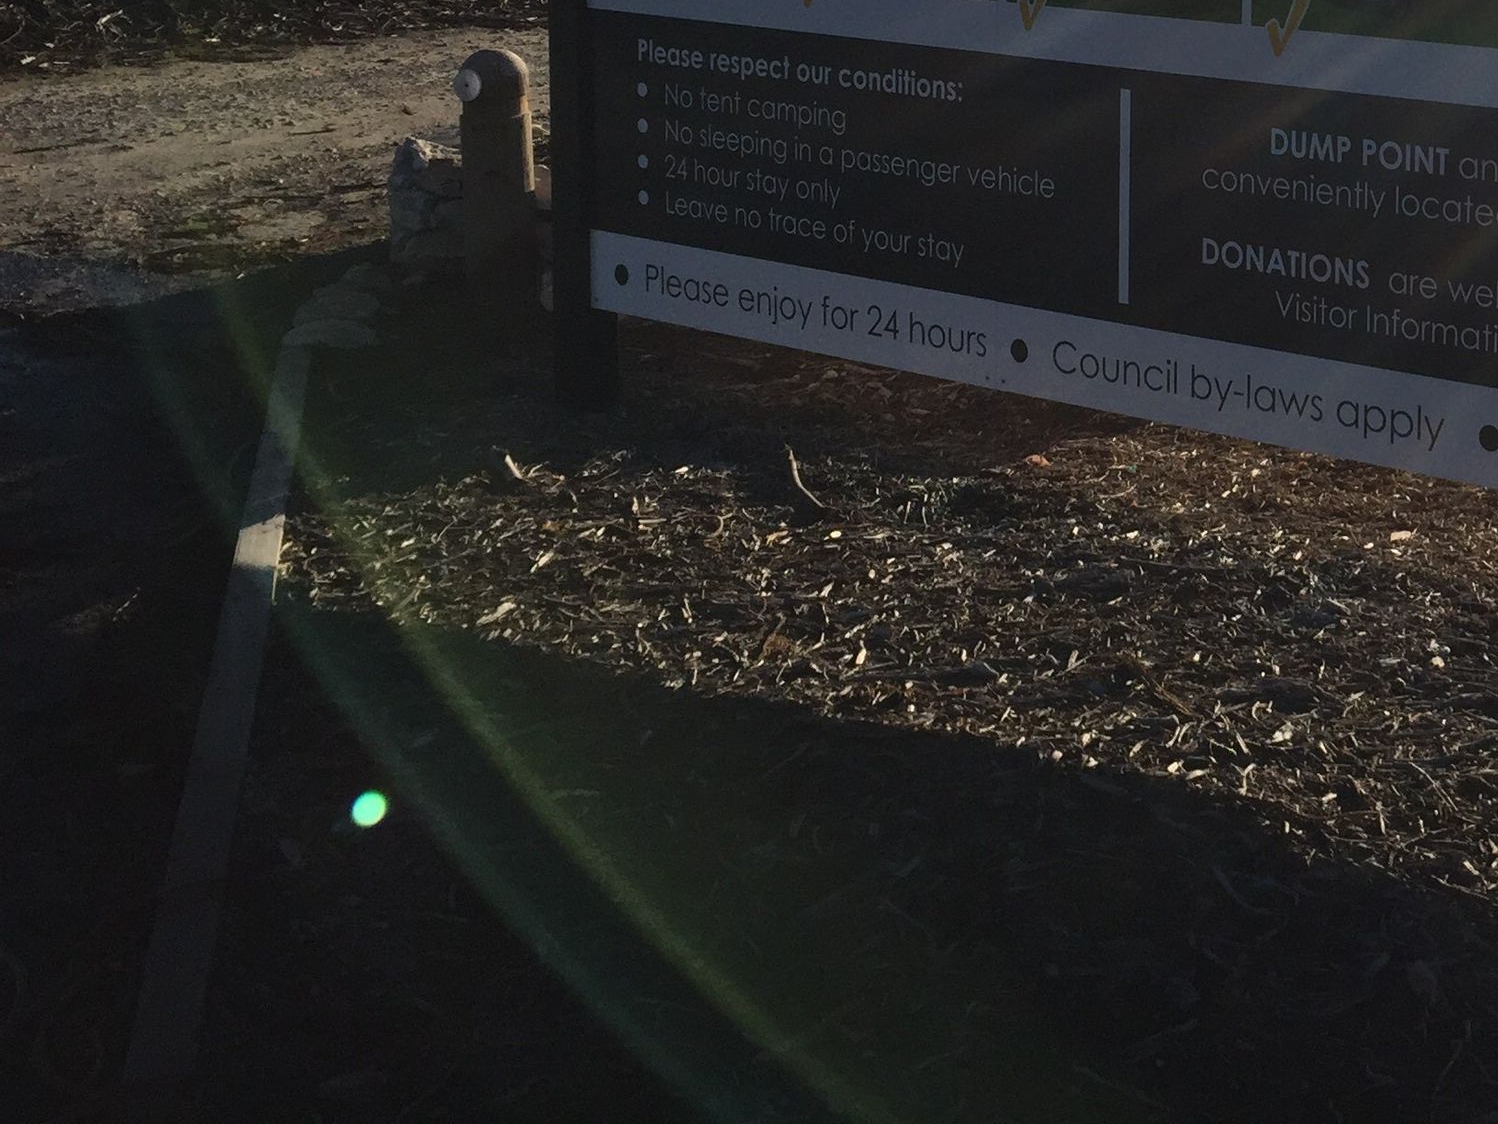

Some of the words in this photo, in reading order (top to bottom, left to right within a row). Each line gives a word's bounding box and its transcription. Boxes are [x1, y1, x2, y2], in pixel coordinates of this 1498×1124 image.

[637, 38, 703, 69] Please
[709, 47, 790, 82] respect
[797, 61, 832, 85] our
[838, 66, 964, 103] conditions:
[664, 83, 694, 109] No
[700, 90, 741, 116] tent
[747, 101, 847, 136] camping
[663, 154, 688, 180] 24
[694, 157, 740, 189] hour
[745, 167, 789, 198] stay
[795, 176, 841, 210] only
[664, 119, 694, 145] No
[699, 124, 787, 163] sleeping
[794, 134, 812, 161] in
[818, 145, 833, 164] a
[841, 146, 959, 187] passenger
[967, 165, 1056, 199] vehicle
[1270, 128, 1352, 163] DUMP
[1361, 140, 1450, 176] POINT
[1201, 168, 1387, 219] conveniently
[665, 190, 728, 225] Leave
[734, 207, 762, 229] no
[768, 211, 827, 240] trace
[832, 220, 856, 244] of
[861, 228, 911, 253] your
[917, 235, 965, 268] stay
[1202, 237, 1371, 290] DONATIONS
[1388, 272, 1438, 299] are
[644, 264, 730, 307] Please
[737, 285, 813, 330] enjoy
[821, 295, 859, 331] for
[867, 305, 900, 340] 24
[908, 312, 988, 358] hours
[1274, 289, 1357, 330] Visitor
[1052, 340, 1178, 394] Council
[1190, 364, 1323, 422] by-laws
[1336, 400, 1446, 451] apply
